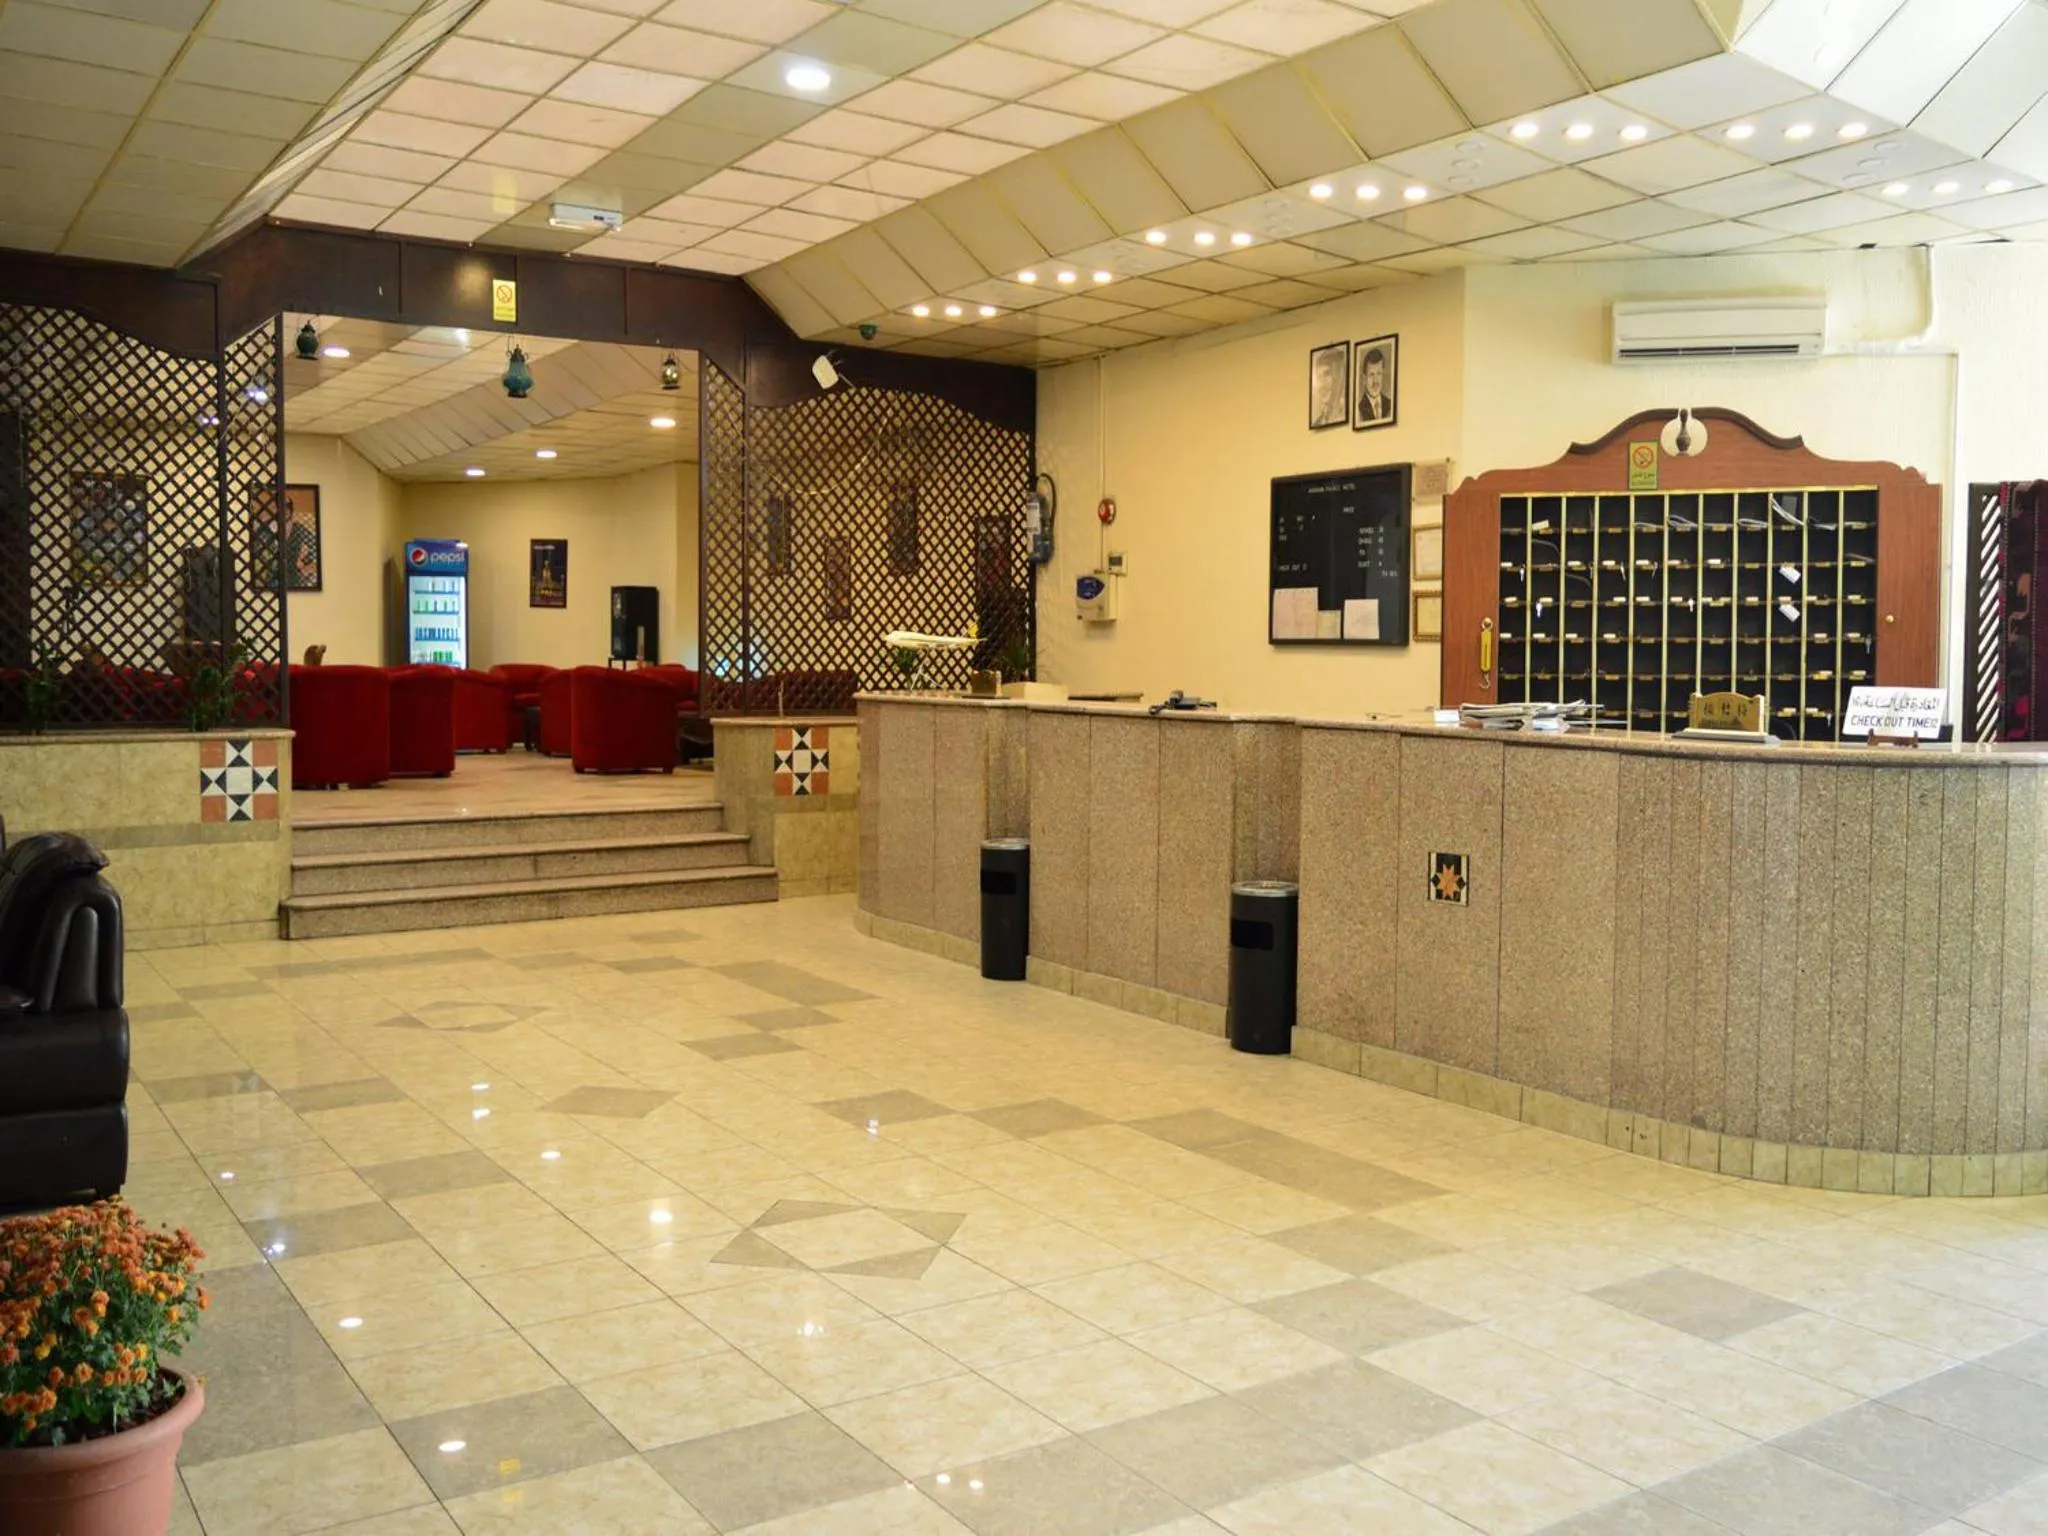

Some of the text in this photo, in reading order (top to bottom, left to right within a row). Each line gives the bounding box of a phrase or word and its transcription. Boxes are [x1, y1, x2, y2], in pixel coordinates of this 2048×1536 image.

[430, 551, 465, 565] pepsi
[1850, 715, 1882, 727] CHECK
[1884, 716, 1904, 727] OUT
